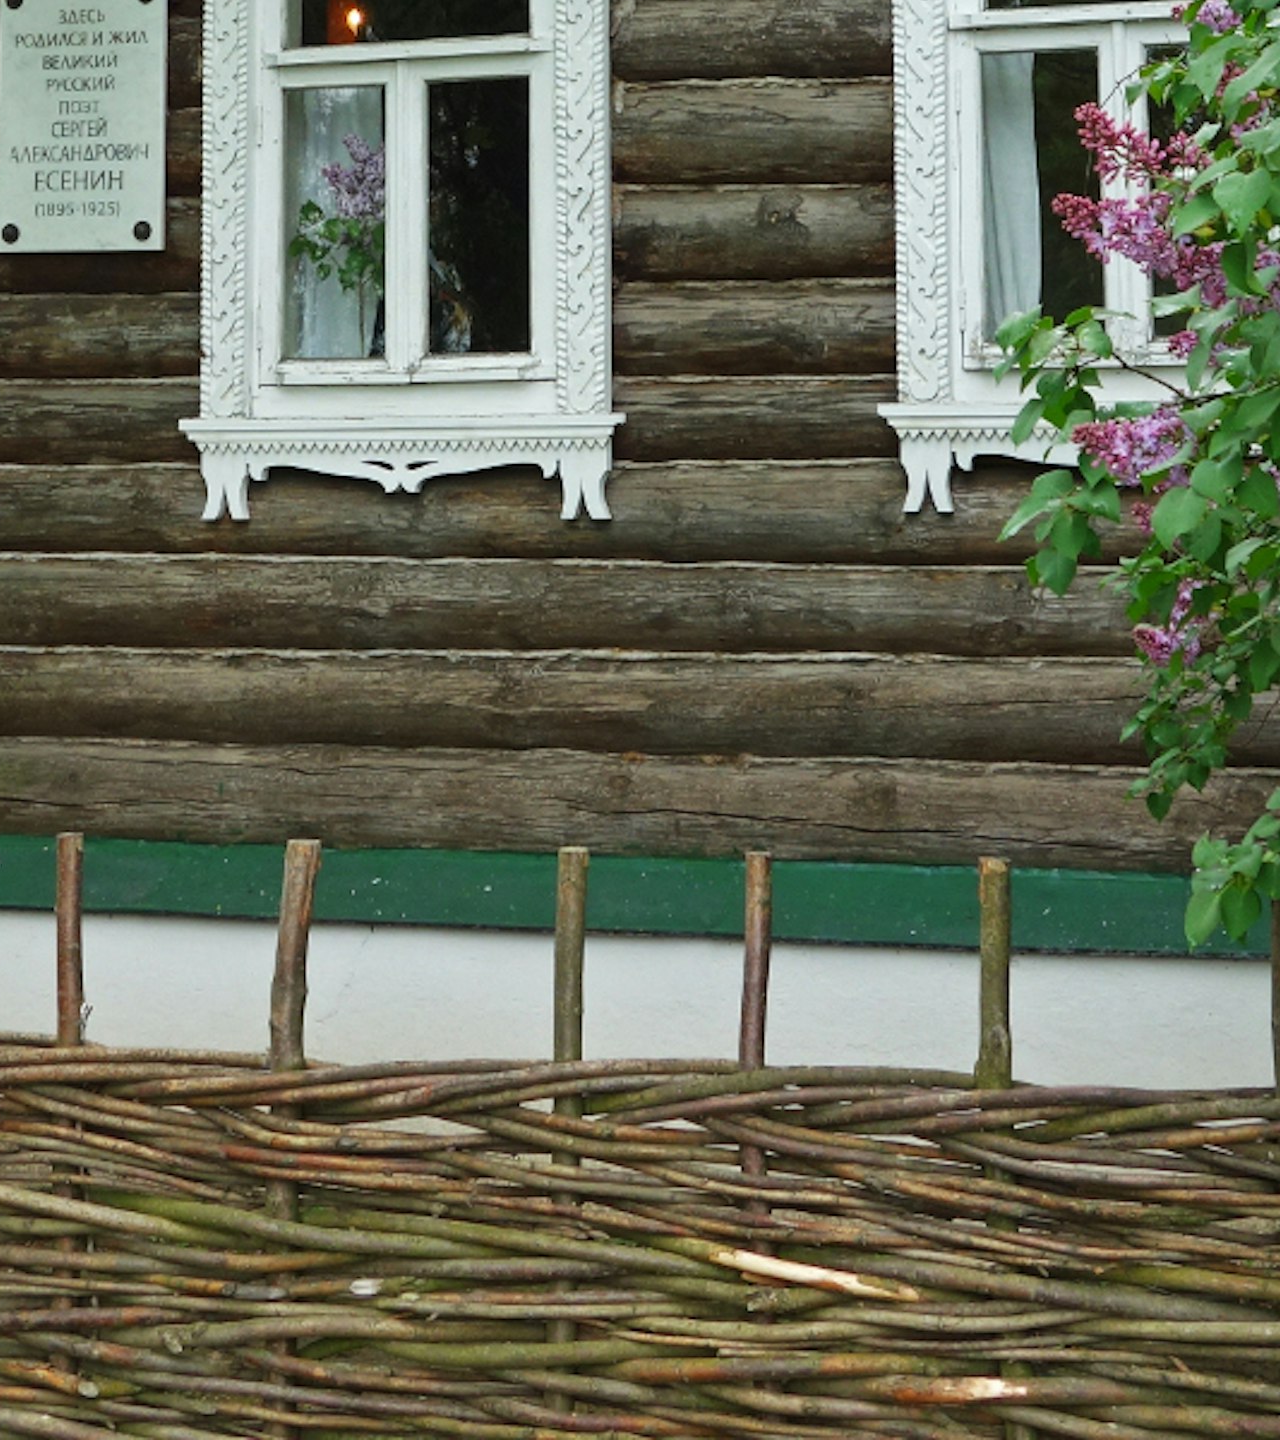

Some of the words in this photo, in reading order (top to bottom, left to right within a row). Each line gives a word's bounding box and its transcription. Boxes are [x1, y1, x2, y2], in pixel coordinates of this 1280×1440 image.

[58, 9, 106, 25] ЗДЕСЬ
[15, 32, 87, 48] РОДИЛСЯ
[91, 32, 103, 46] И
[108, 31, 149, 45] ЖИЛ
[42, 53, 118, 70] ВЕЛИКИЙ
[46, 75, 115, 92] РУССКИЙ
[58, 100, 99, 115] ПОЭТ
[51, 117, 108, 138] СЕРГЕЙ
[10, 143, 149, 163] АЛЕКСАНДРОВИЧ
[34, 170, 124, 192] ЕСЕНИН
